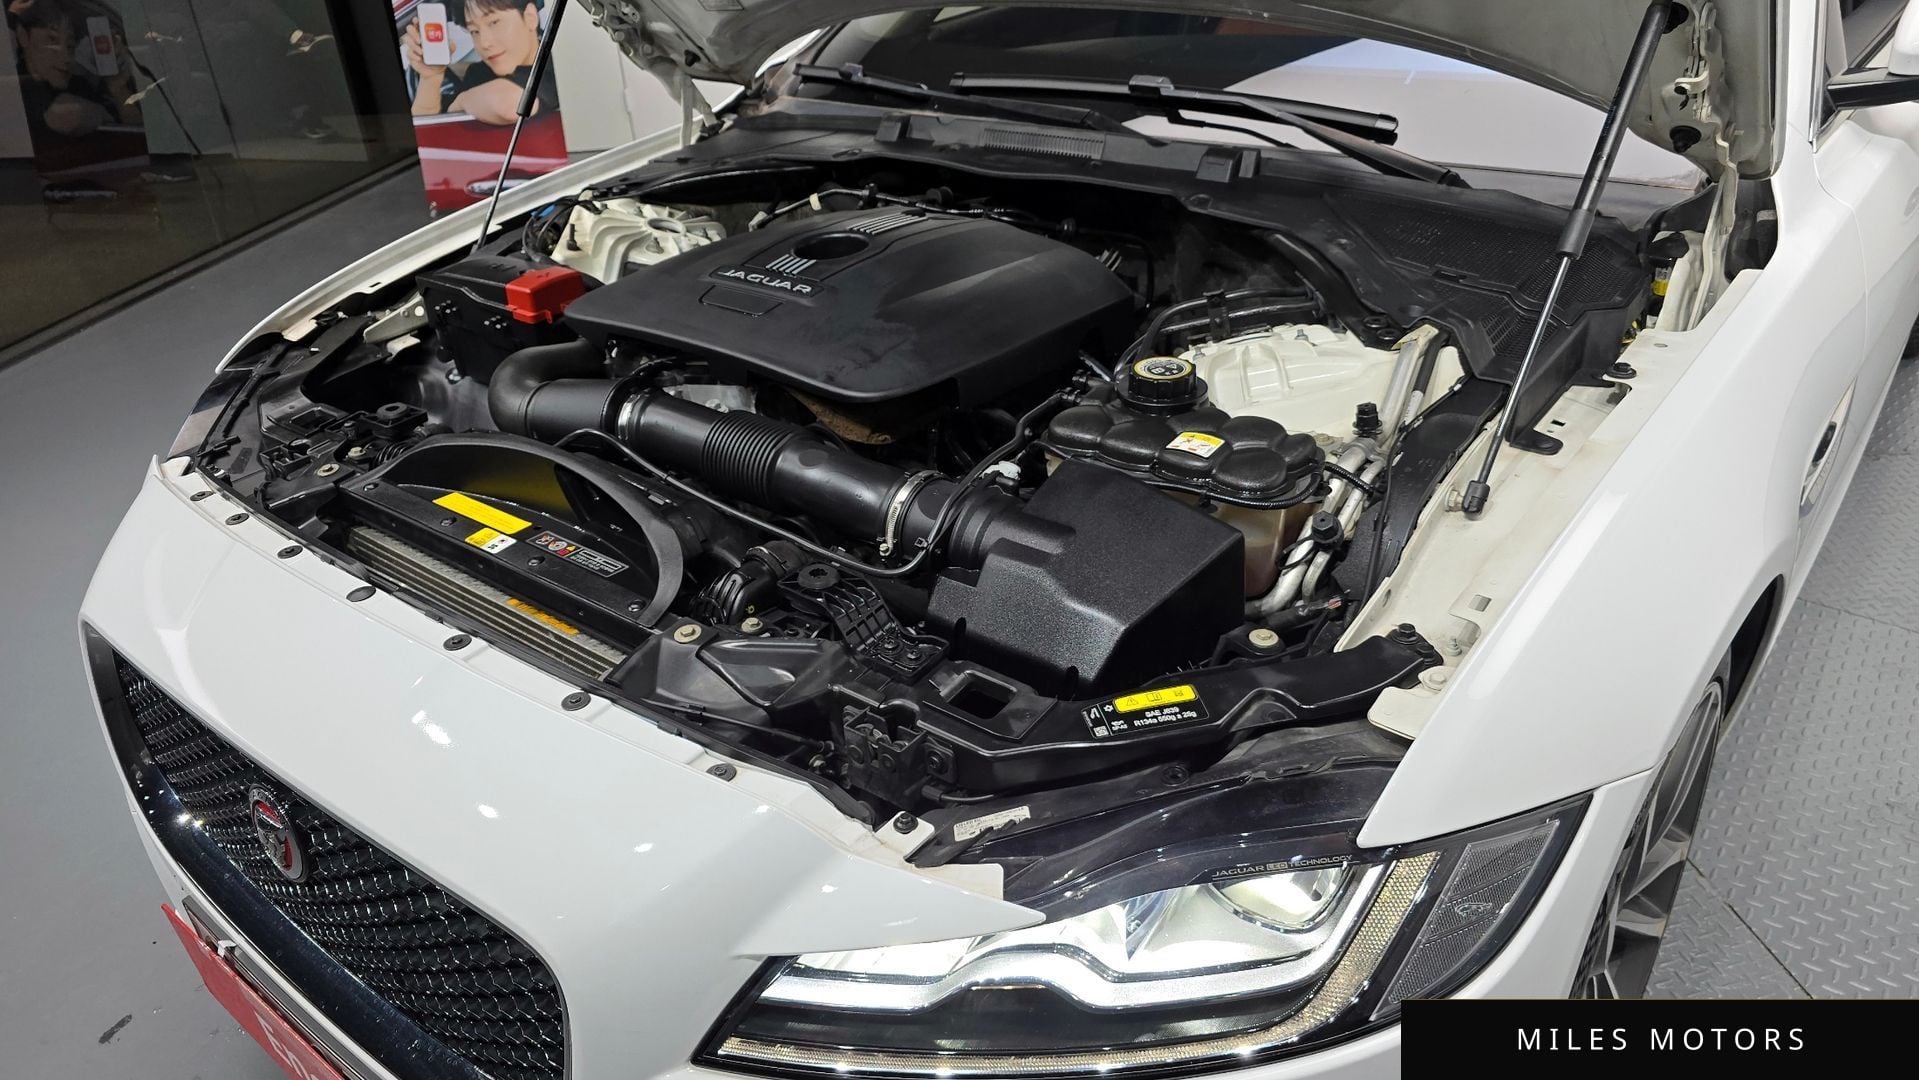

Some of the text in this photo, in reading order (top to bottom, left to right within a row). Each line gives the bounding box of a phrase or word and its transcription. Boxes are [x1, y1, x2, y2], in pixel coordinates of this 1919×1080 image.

[718, 269, 812, 294] JAGUAR
[1145, 709, 1162, 718] SAE
[1133, 717, 1158, 727] R134a
[1212, 865, 1265, 877] JAGUAR
[1288, 855, 1353, 868] TECHNOLOGY
